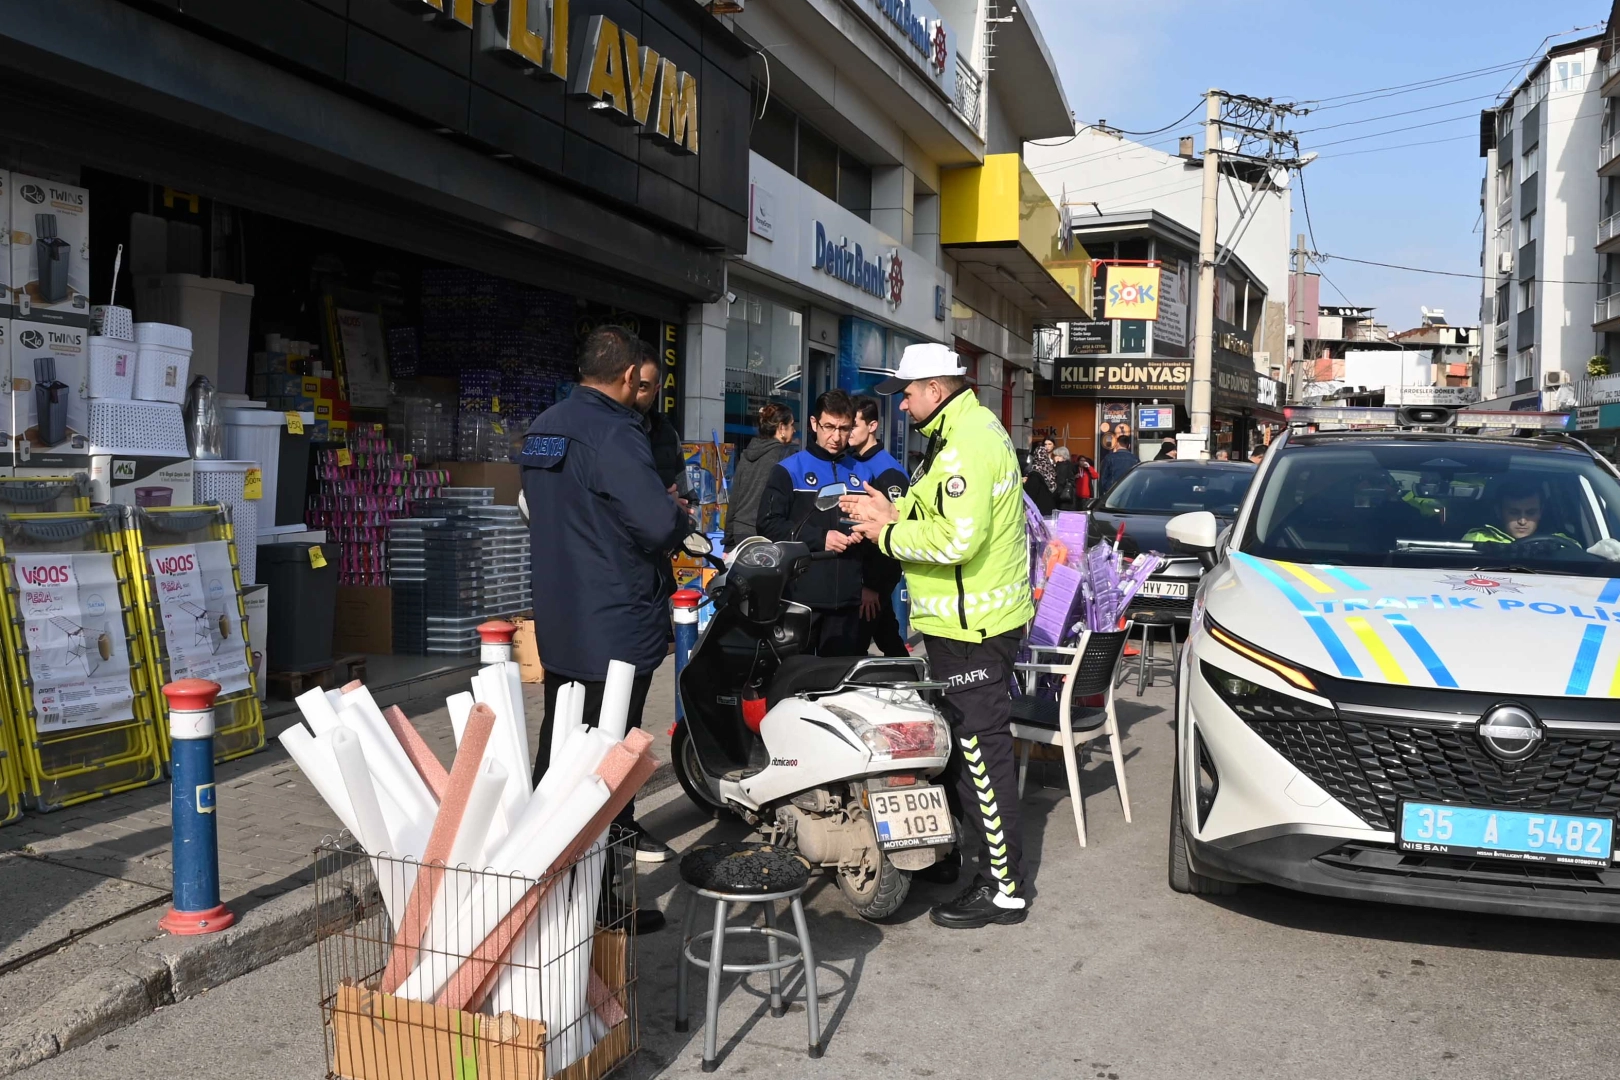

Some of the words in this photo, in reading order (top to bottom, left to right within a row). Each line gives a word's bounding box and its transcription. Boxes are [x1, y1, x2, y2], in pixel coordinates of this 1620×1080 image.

[585, 15, 698, 155] AVM
[49, 188, 83, 205] TWINS
[813, 219, 886, 299] DenizBank
[1109, 284, 1155, 307] ŞOK
[21, 329, 42, 348] Rio
[48, 332, 81, 345] TWINS
[1061, 367, 1105, 382] KILIF
[1108, 363, 1191, 382] DÜNYASI
[522, 436, 565, 456] ZABITA
[1143, 582, 1162, 594] HVV
[1166, 584, 1185, 595] 770
[1315, 594, 1486, 614] TRAFİK
[1481, 727, 1540, 738] NISSAN
[875, 795, 900, 814] 35
[904, 791, 942, 811] BON
[903, 815, 938, 835] 103
[1417, 808, 1453, 840] 35
[1483, 814, 1498, 845] A
[1527, 817, 1603, 853] 5482
[883, 838, 920, 849] MOTOROM
[1403, 842, 1448, 853] NISSAN
